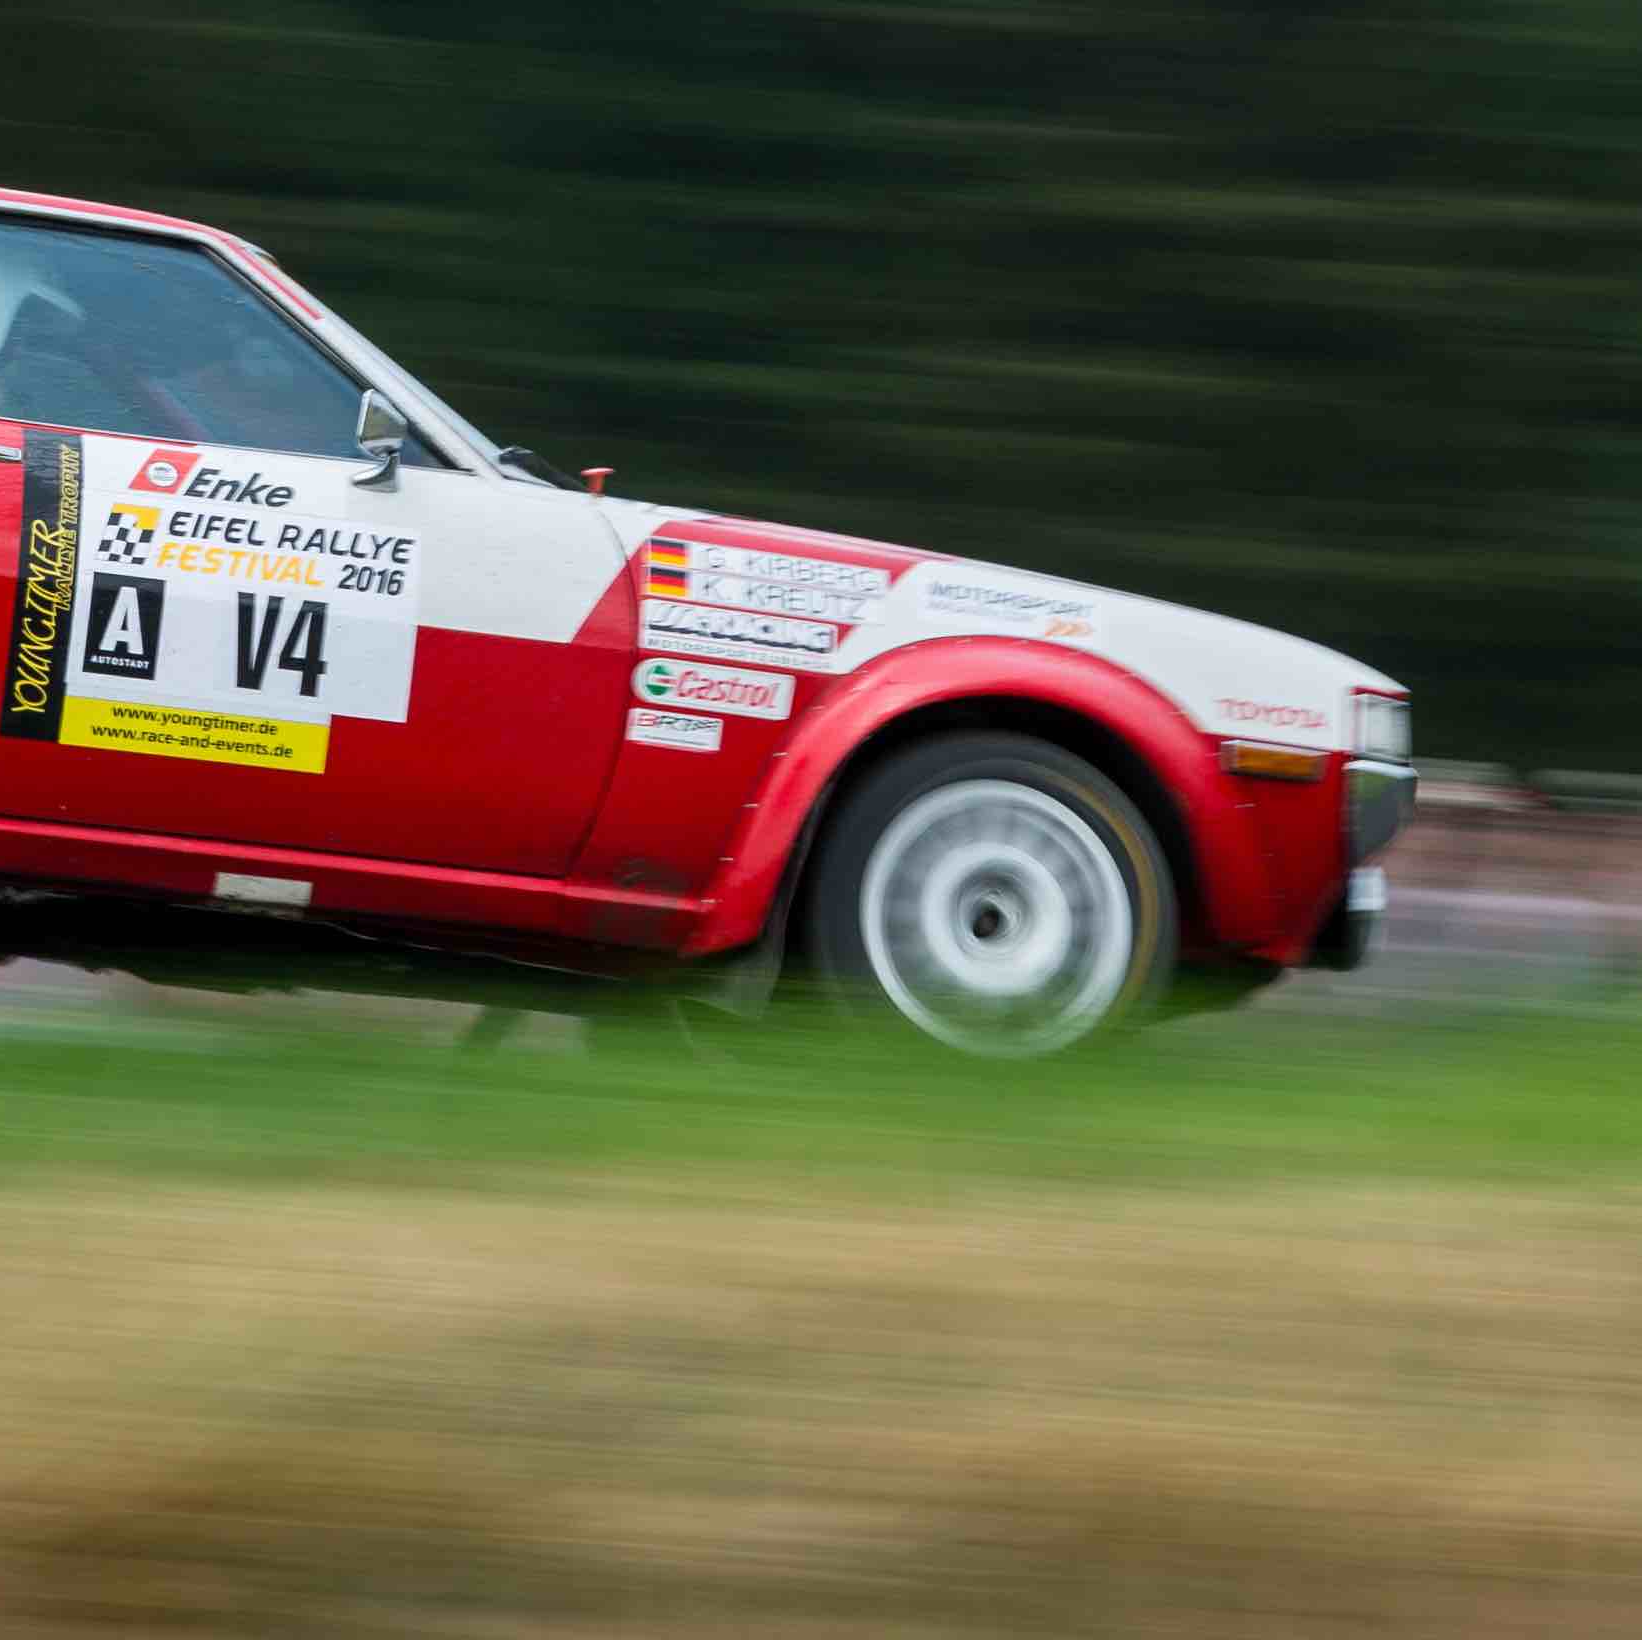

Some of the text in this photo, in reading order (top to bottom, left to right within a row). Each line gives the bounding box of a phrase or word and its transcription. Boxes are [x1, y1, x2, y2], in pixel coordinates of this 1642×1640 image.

[182, 467, 298, 509] Enke
[168, 510, 413, 565] EIFEL RALLYE
[156, 542, 325, 588] FESTIVAL
[337, 564, 406, 597] 2016
[10, 519, 65, 715] YOUNGTIMER
[98, 585, 146, 656] A
[90, 655, 150, 671] AUTOSTADT
[236, 591, 329, 698] V4
[676, 668, 781, 711] Castrol
[91, 724, 293, 760] www.race-and-events.de
[112, 706, 279, 737] www.youngtimer.de
